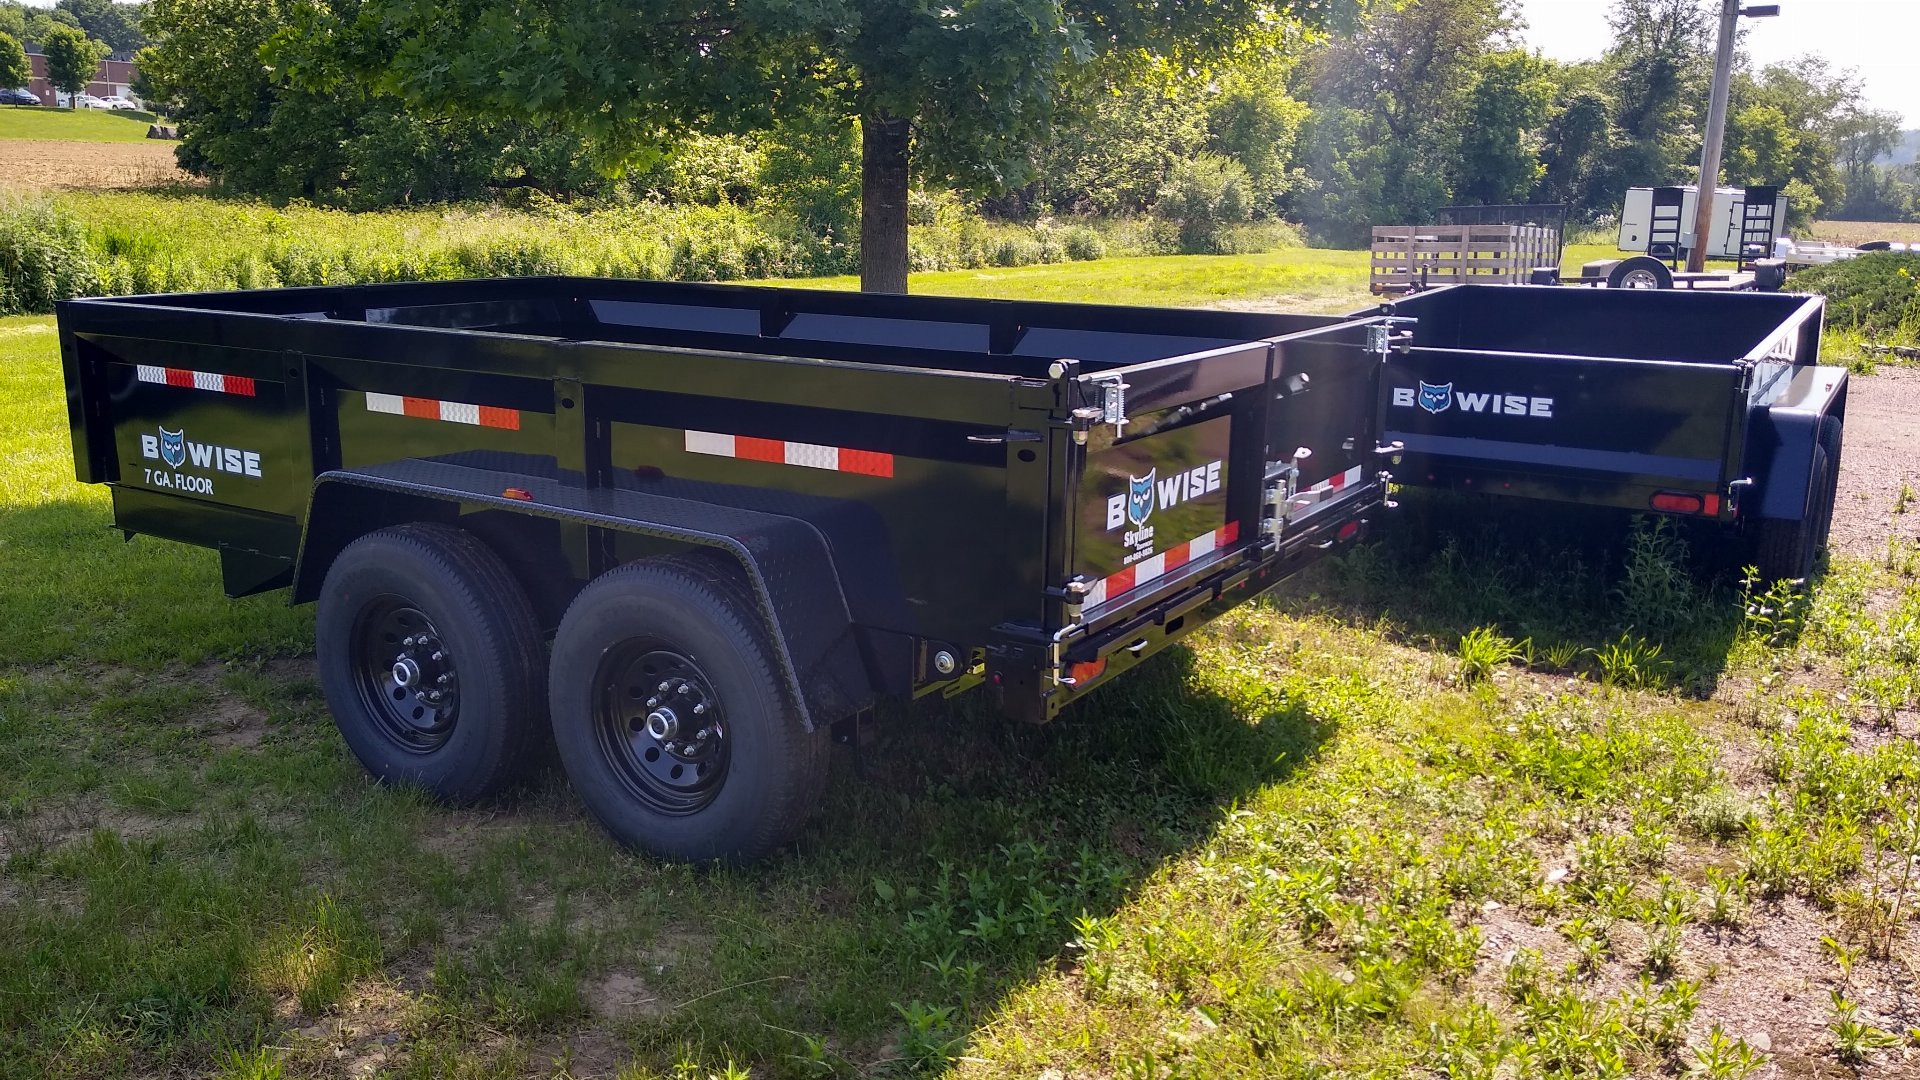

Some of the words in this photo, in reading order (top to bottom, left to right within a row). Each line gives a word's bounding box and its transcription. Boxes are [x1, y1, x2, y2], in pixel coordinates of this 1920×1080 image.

[144, 468, 151, 484] 7
[153, 470, 174, 489] GA.
[175, 474, 214, 495] FLOOR
[1124, 526, 1154, 548] Skyline
